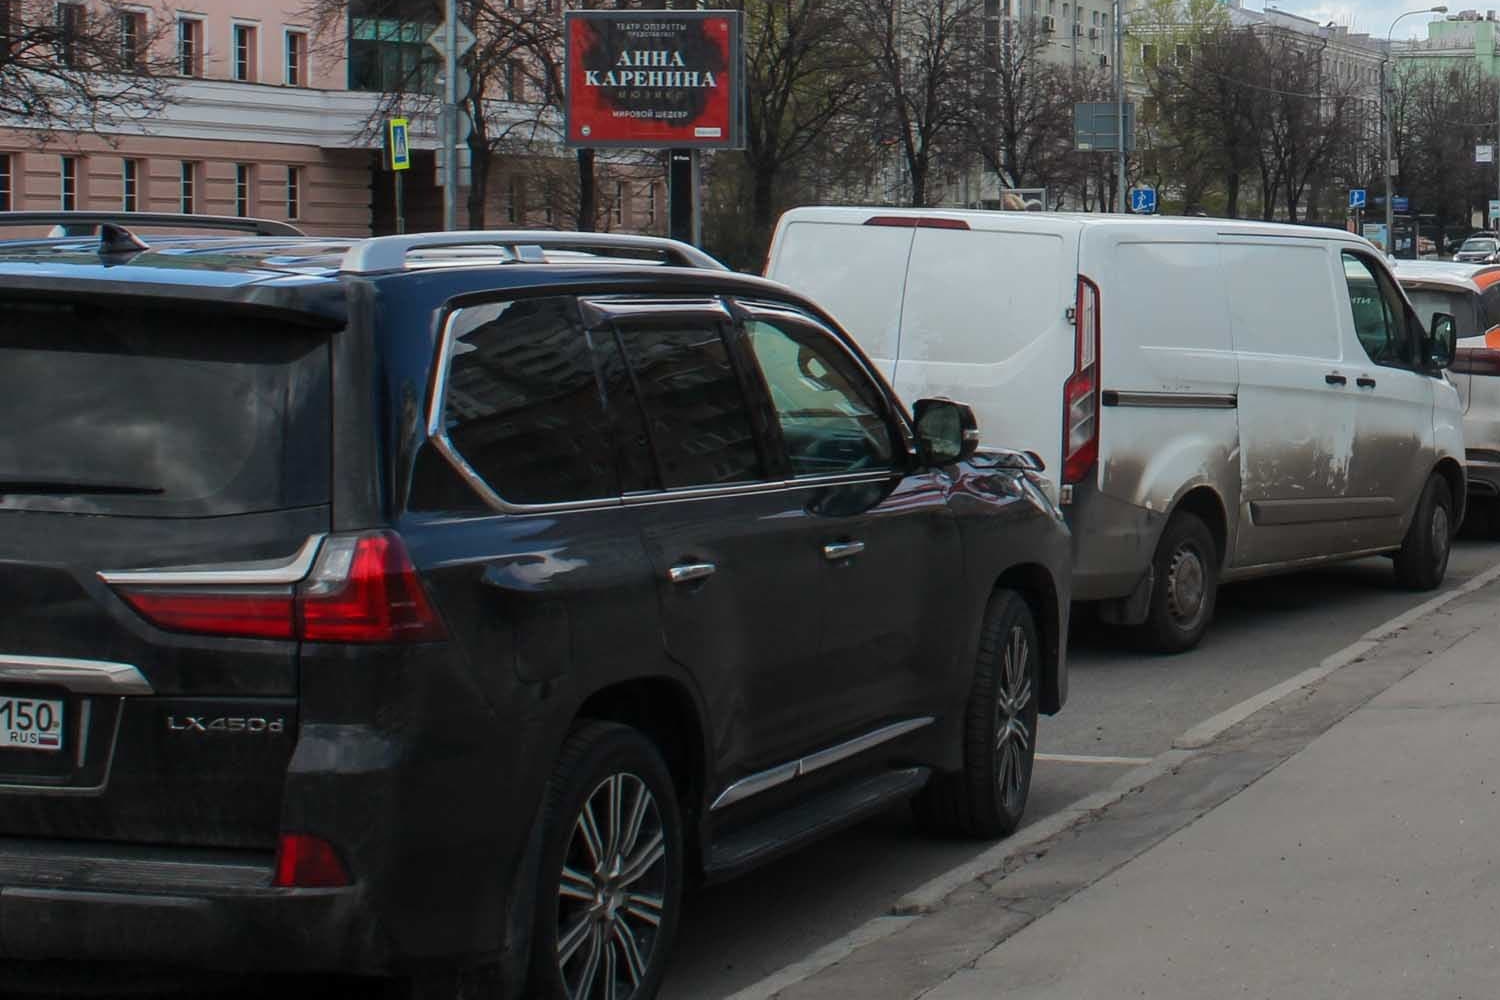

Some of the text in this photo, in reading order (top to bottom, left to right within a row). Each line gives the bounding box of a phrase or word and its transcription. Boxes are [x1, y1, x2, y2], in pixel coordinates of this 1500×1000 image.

[616, 50, 686, 67] АННА
[584, 70, 718, 88] КАРЕНИНА
[612, 108, 688, 119] МИРОВОЙ ШЕДЕВР
[0, 701, 53, 731] 150
[168, 716, 284, 733] LX450d
[10, 731, 37, 744] RUS
